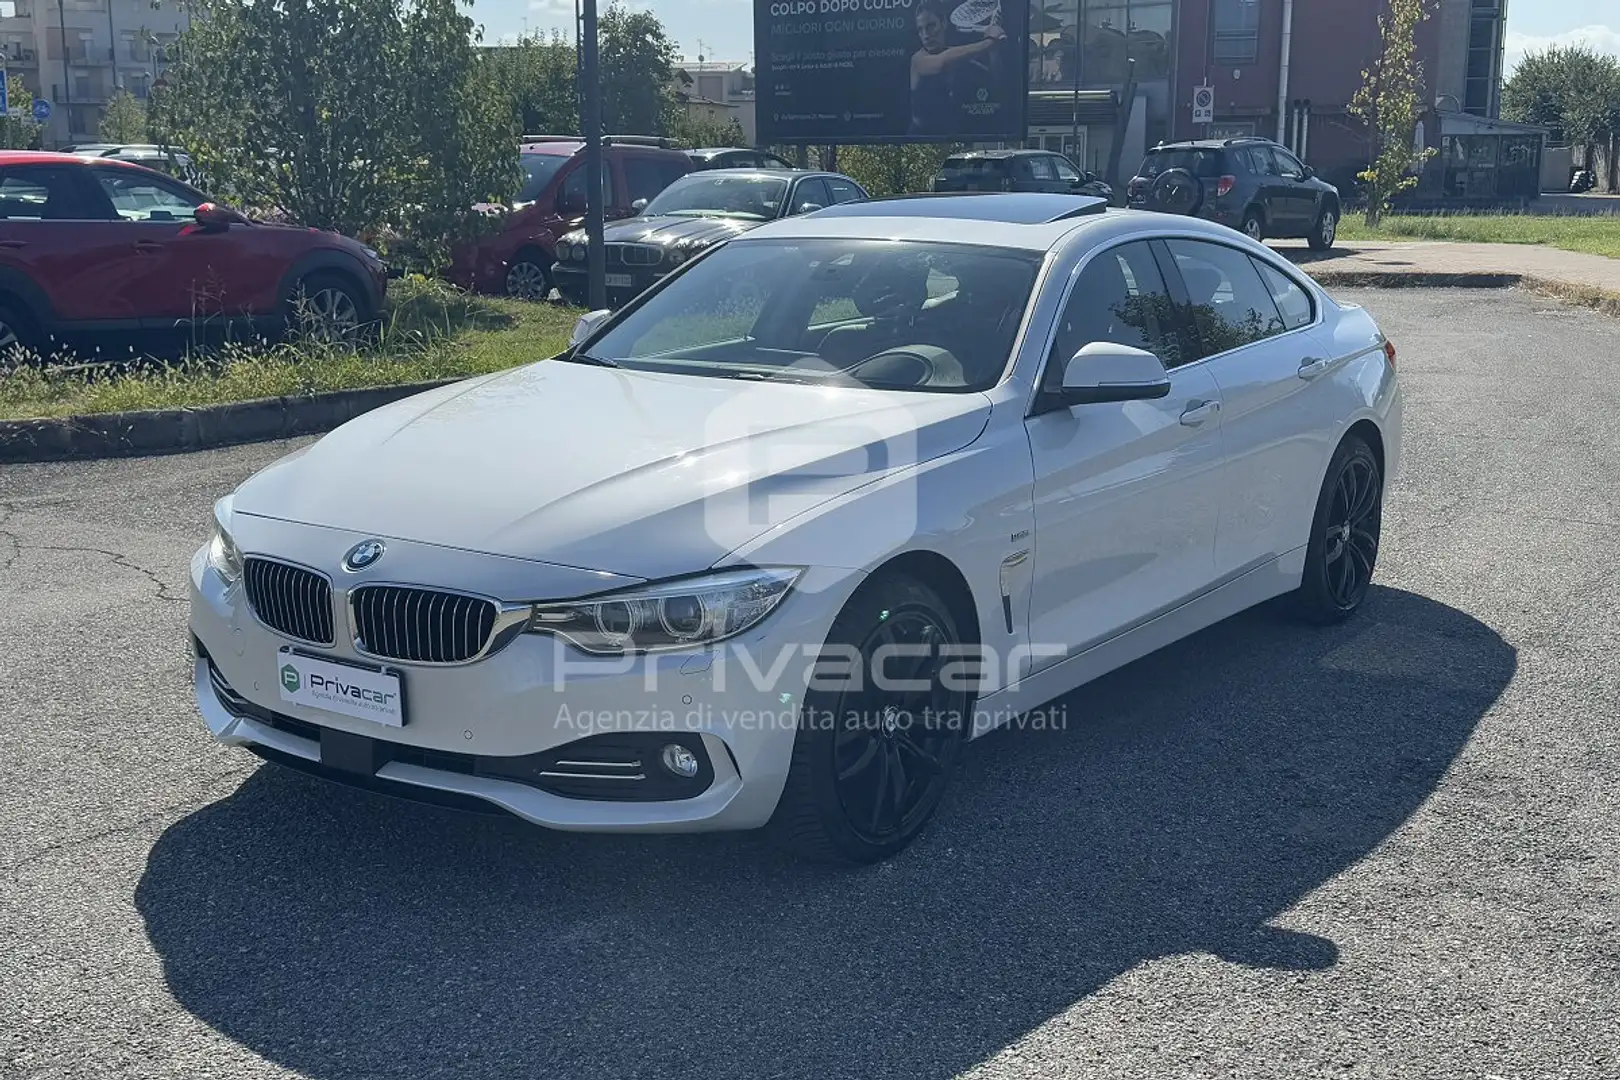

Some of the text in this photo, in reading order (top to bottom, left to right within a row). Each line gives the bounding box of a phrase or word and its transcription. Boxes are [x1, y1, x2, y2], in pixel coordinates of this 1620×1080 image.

[771, 0, 912, 16] COLPO DOPO COLPO
[771, 17, 905, 35] MIGLIORI OGNI GIORNO
[310, 674, 394, 705] Privacar
